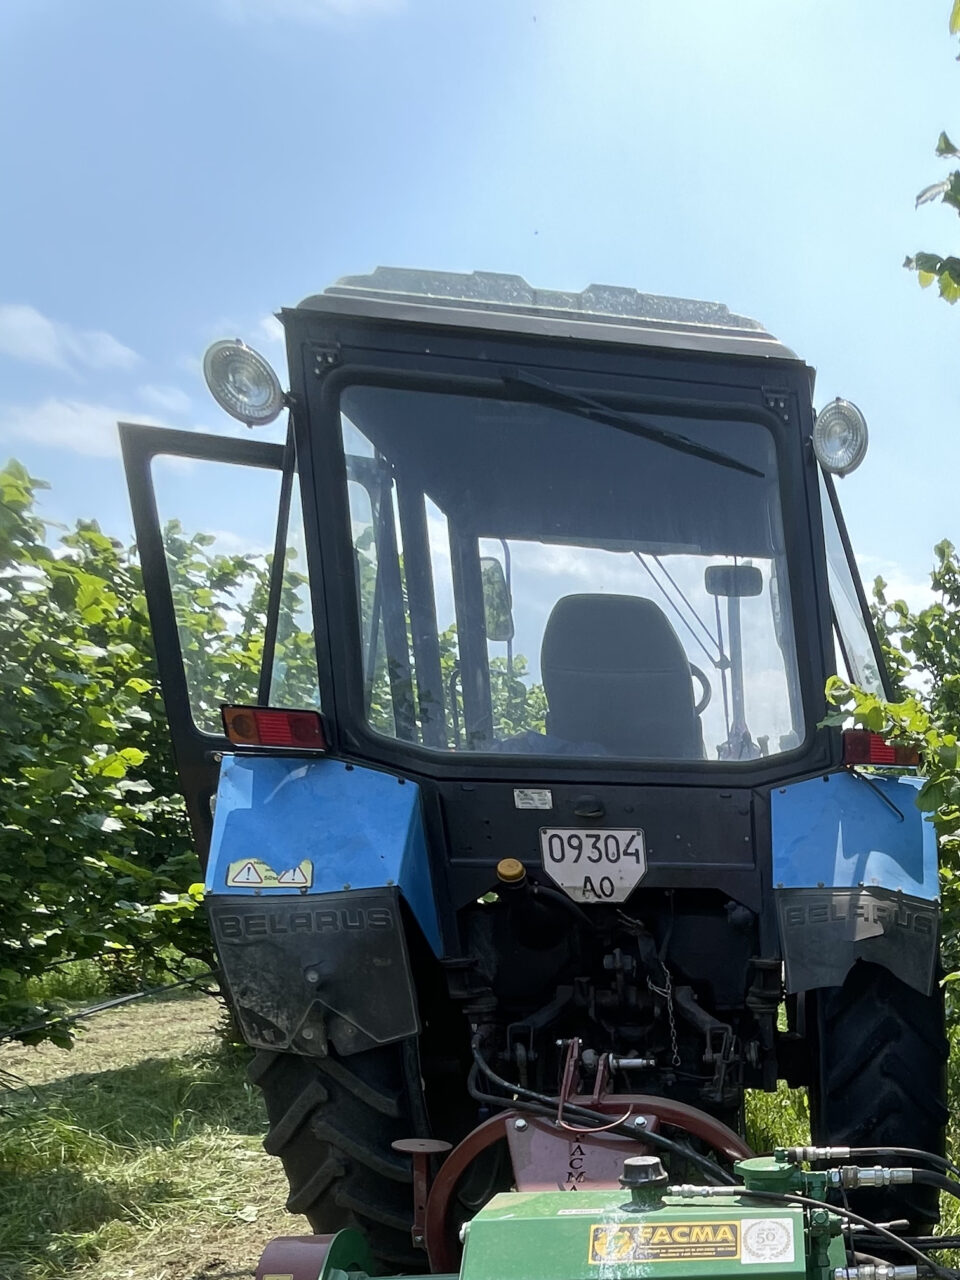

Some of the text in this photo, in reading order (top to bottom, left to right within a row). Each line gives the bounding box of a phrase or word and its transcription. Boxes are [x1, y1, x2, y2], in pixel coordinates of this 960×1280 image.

[548, 833, 641, 864] 09304
[582, 876, 615, 899] AO
[217, 907, 394, 939] BELARUS
[783, 902, 933, 935] BELARUS
[638, 1224, 735, 1243] FACMA
